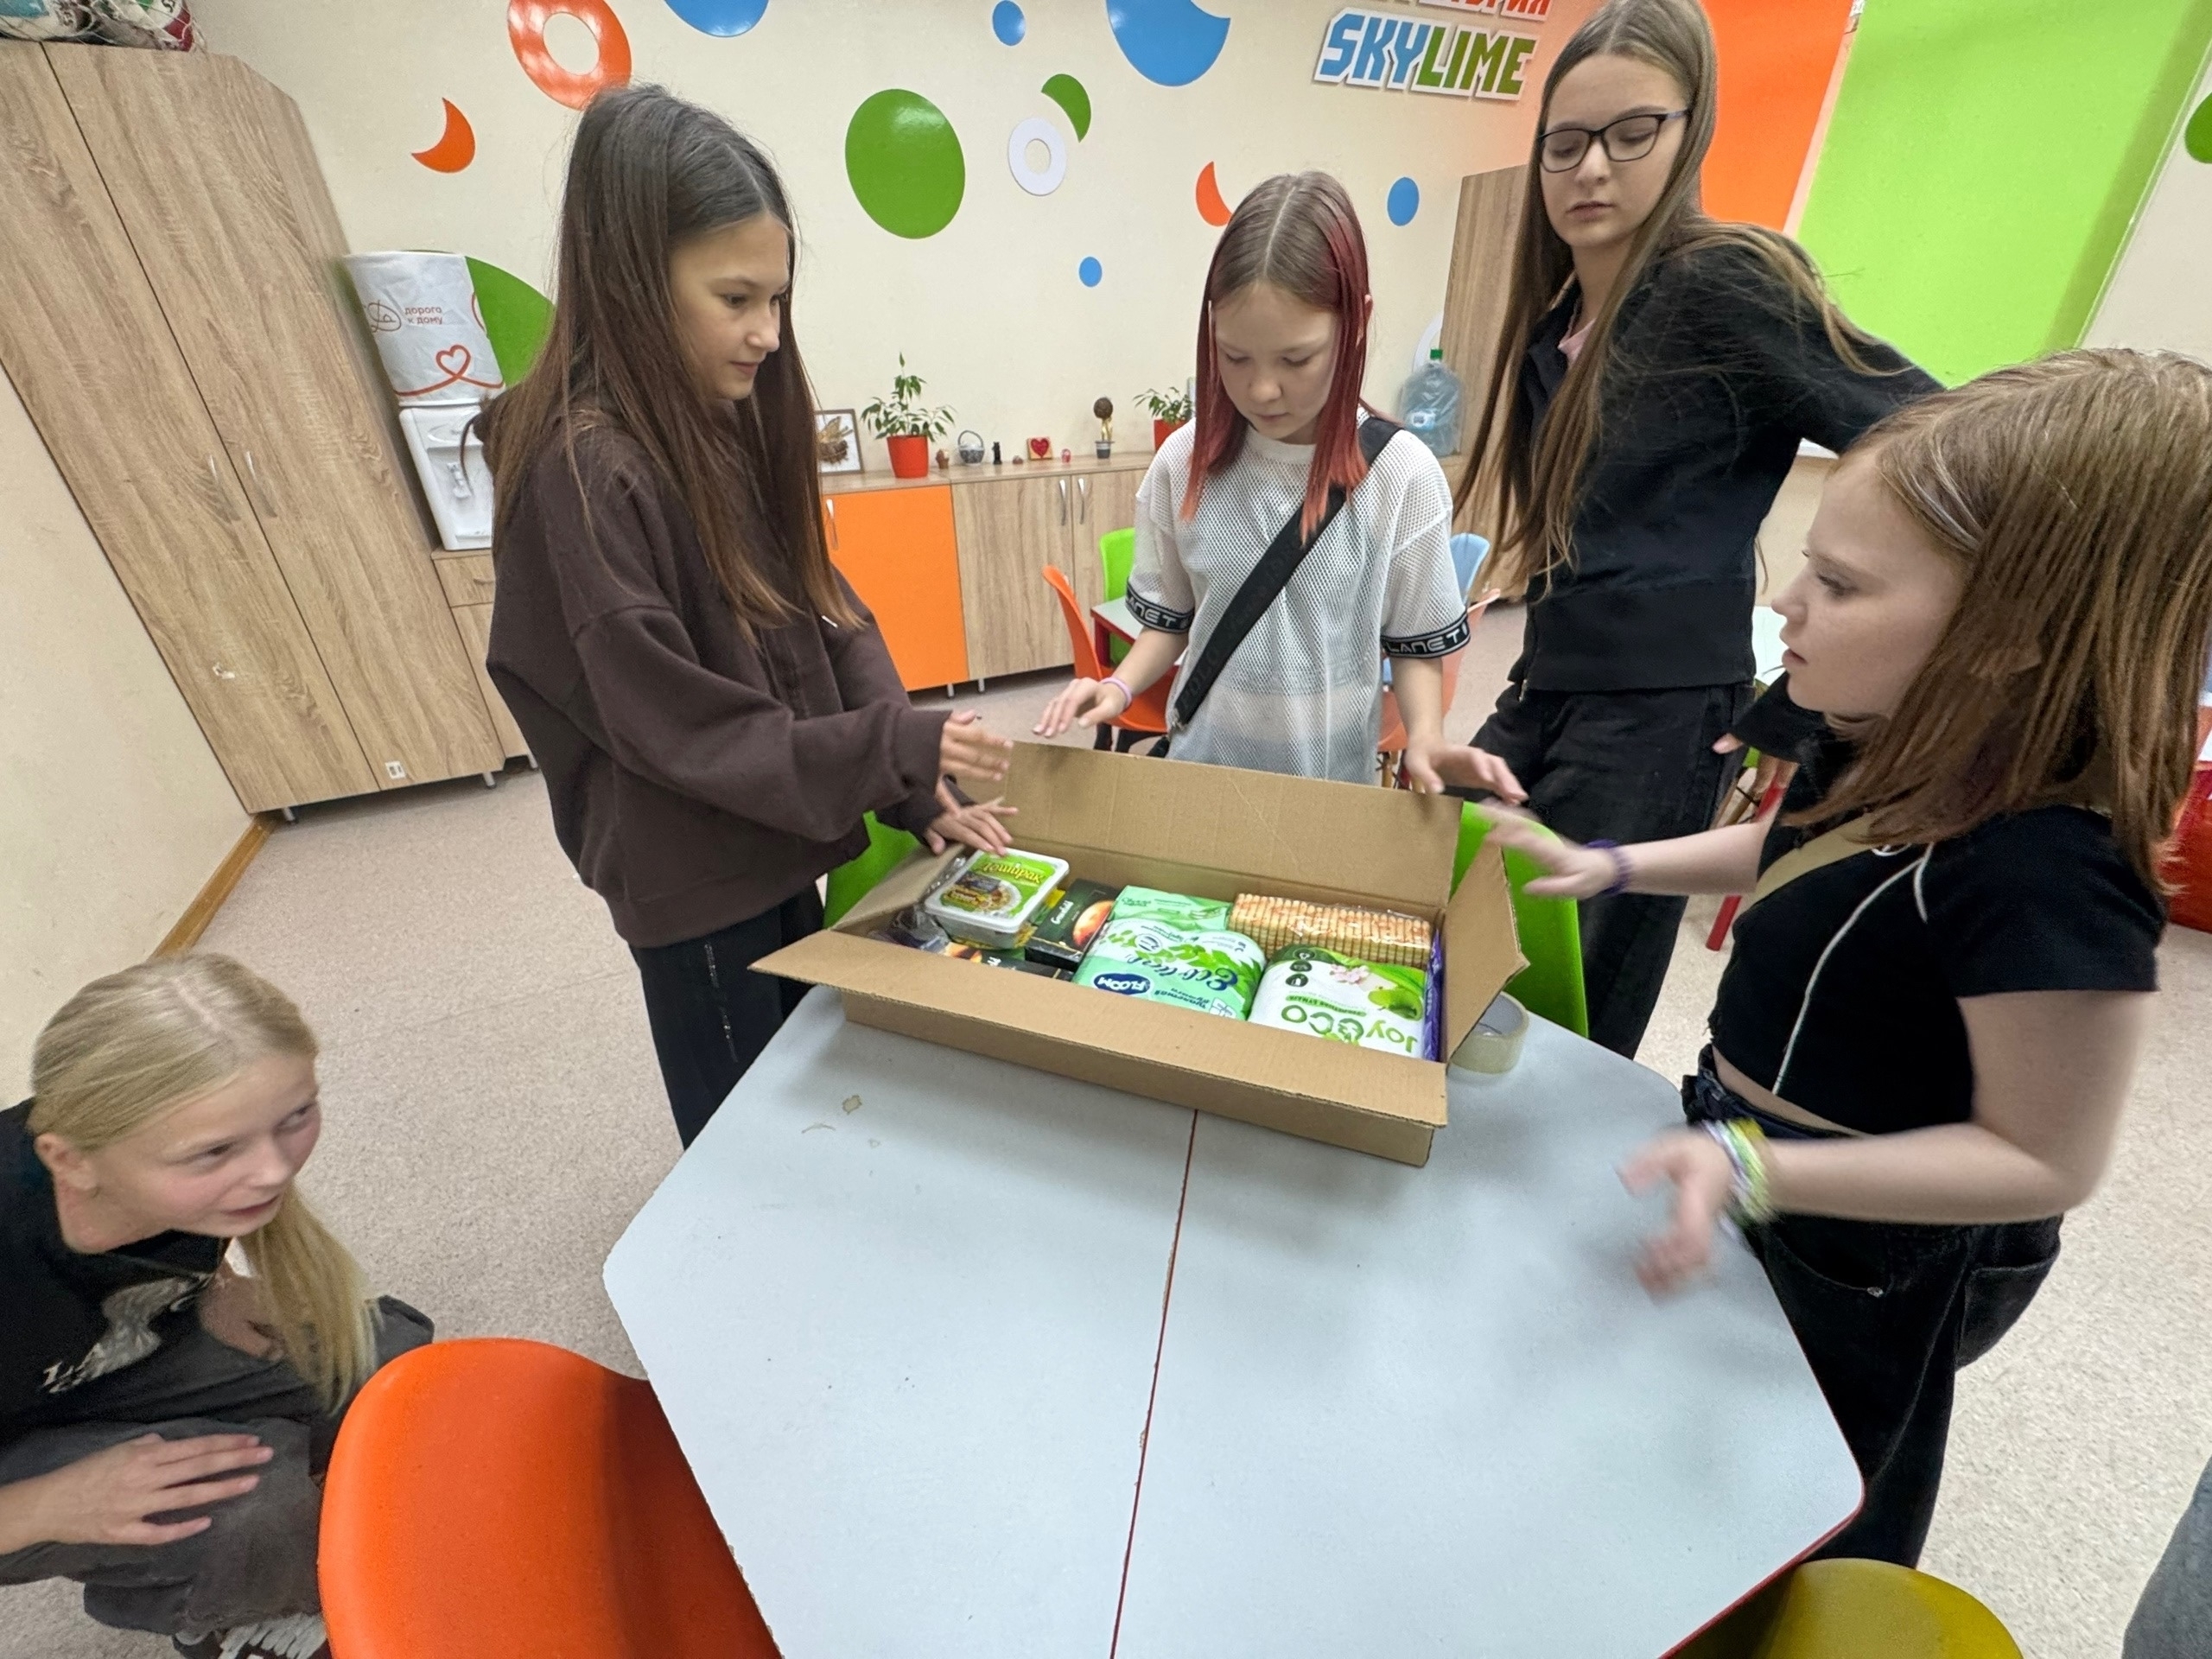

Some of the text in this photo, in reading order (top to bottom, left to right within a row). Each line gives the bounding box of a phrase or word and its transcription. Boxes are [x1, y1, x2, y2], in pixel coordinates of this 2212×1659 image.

[1318, 12, 1539, 96] SKYLIME
[404, 306, 442, 316] дорога
[416, 315, 442, 325] дому
[1096, 976, 1149, 993] FLOOM
[1179, 967, 1239, 992] Eco
